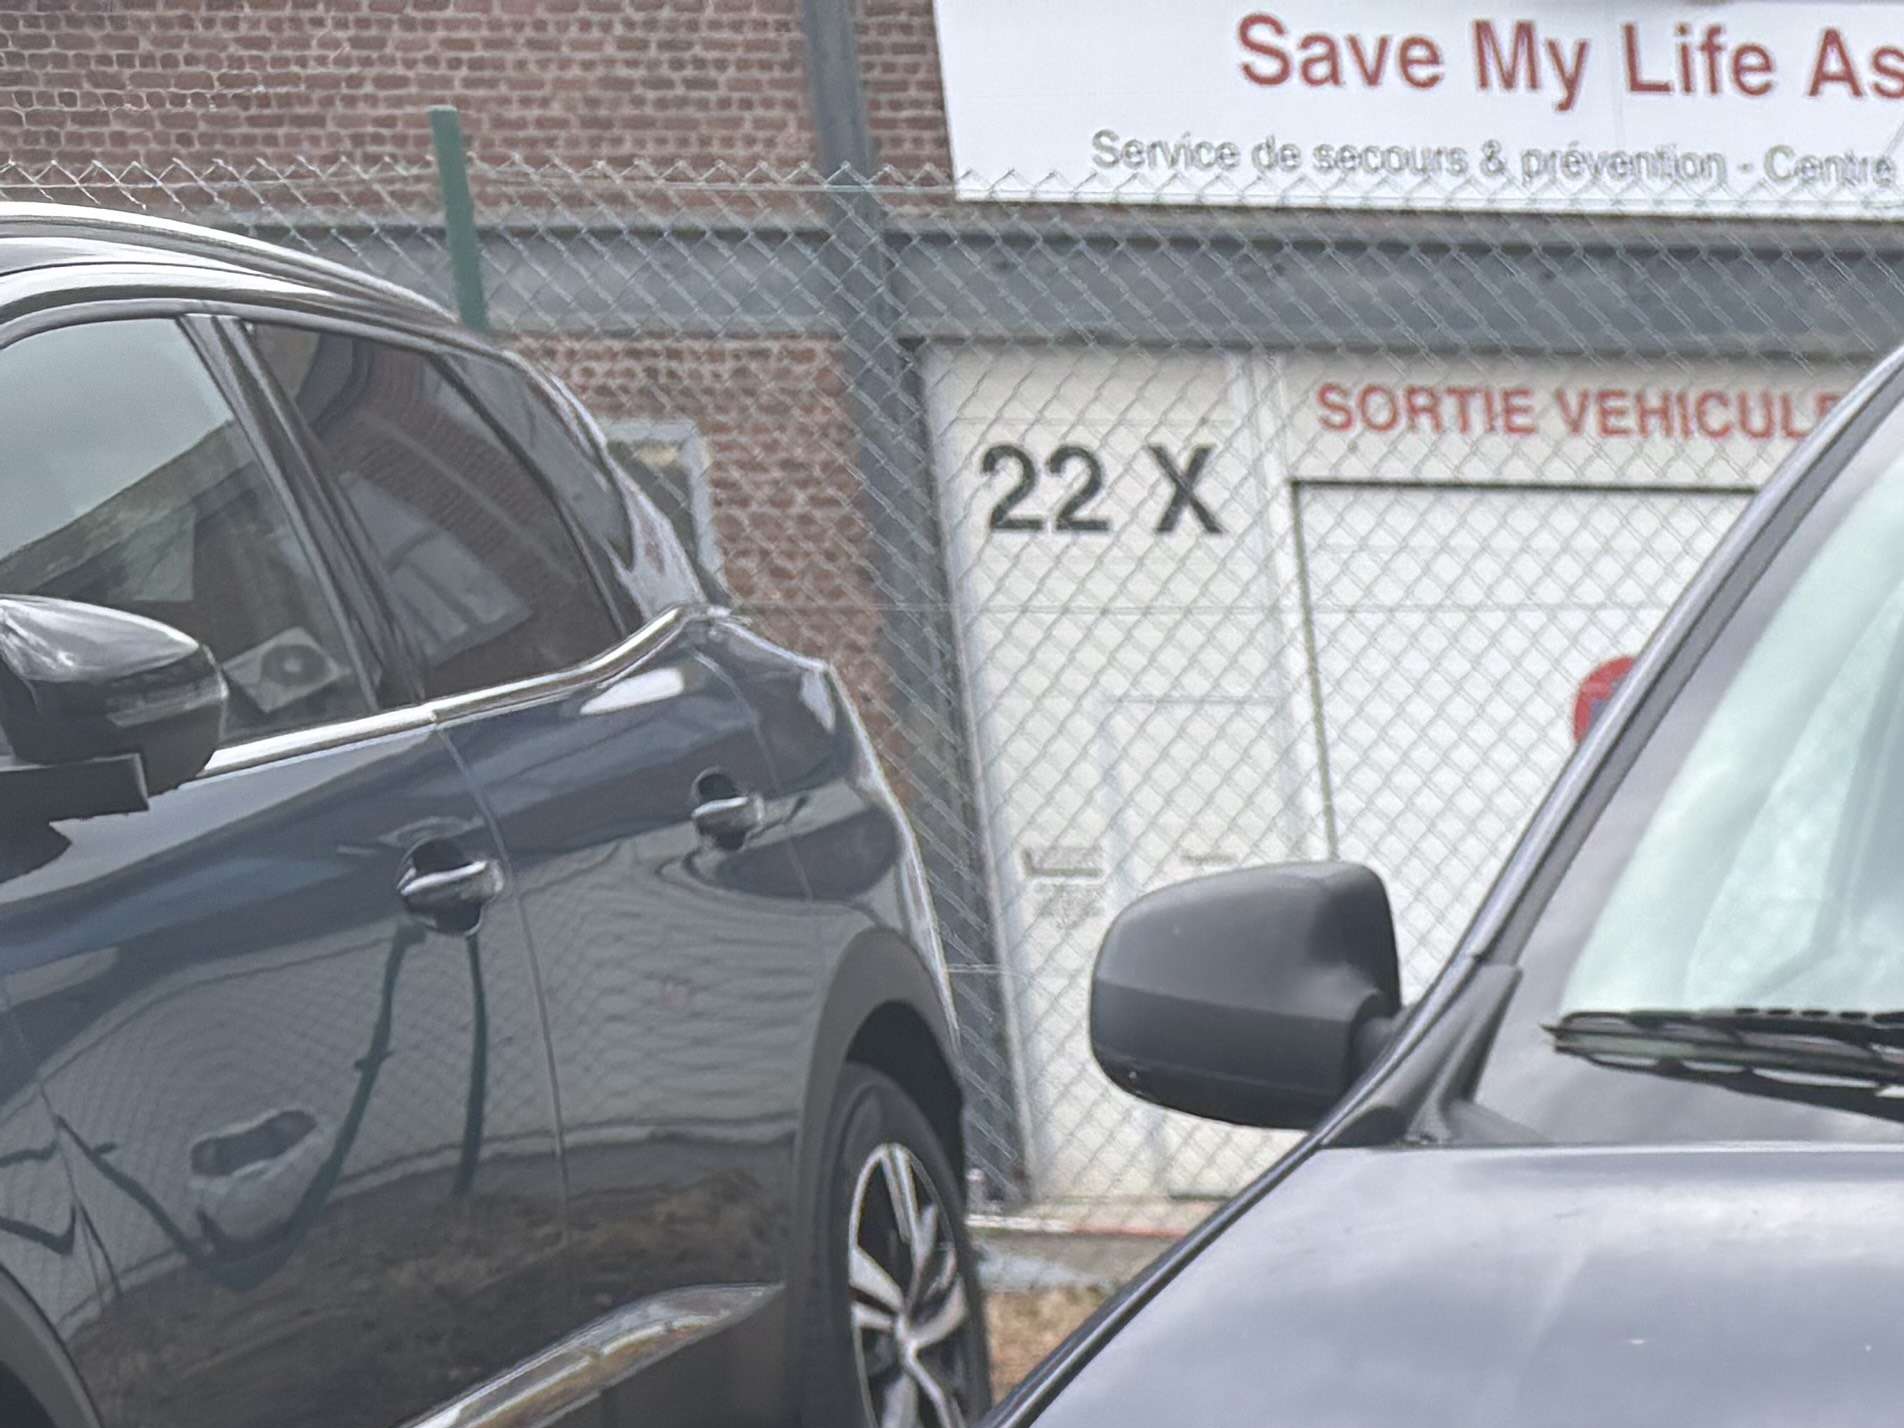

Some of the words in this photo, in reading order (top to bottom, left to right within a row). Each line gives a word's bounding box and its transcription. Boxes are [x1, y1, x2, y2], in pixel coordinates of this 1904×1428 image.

[1237, 13, 1444, 88] Save
[1472, 19, 1592, 112] My
[1623, 22, 1775, 96] Life
[1091, 128, 1241, 169] Service
[1251, 134, 1302, 173] de
[1312, 142, 1470, 176] secours
[1480, 139, 1507, 177] &
[1521, 141, 1728, 187] prévention
[1763, 144, 1896, 187] Centre
[1316, 383, 1538, 435] SORTIE
[983, 445, 1111, 531] 22
[1148, 443, 1222, 533] X
